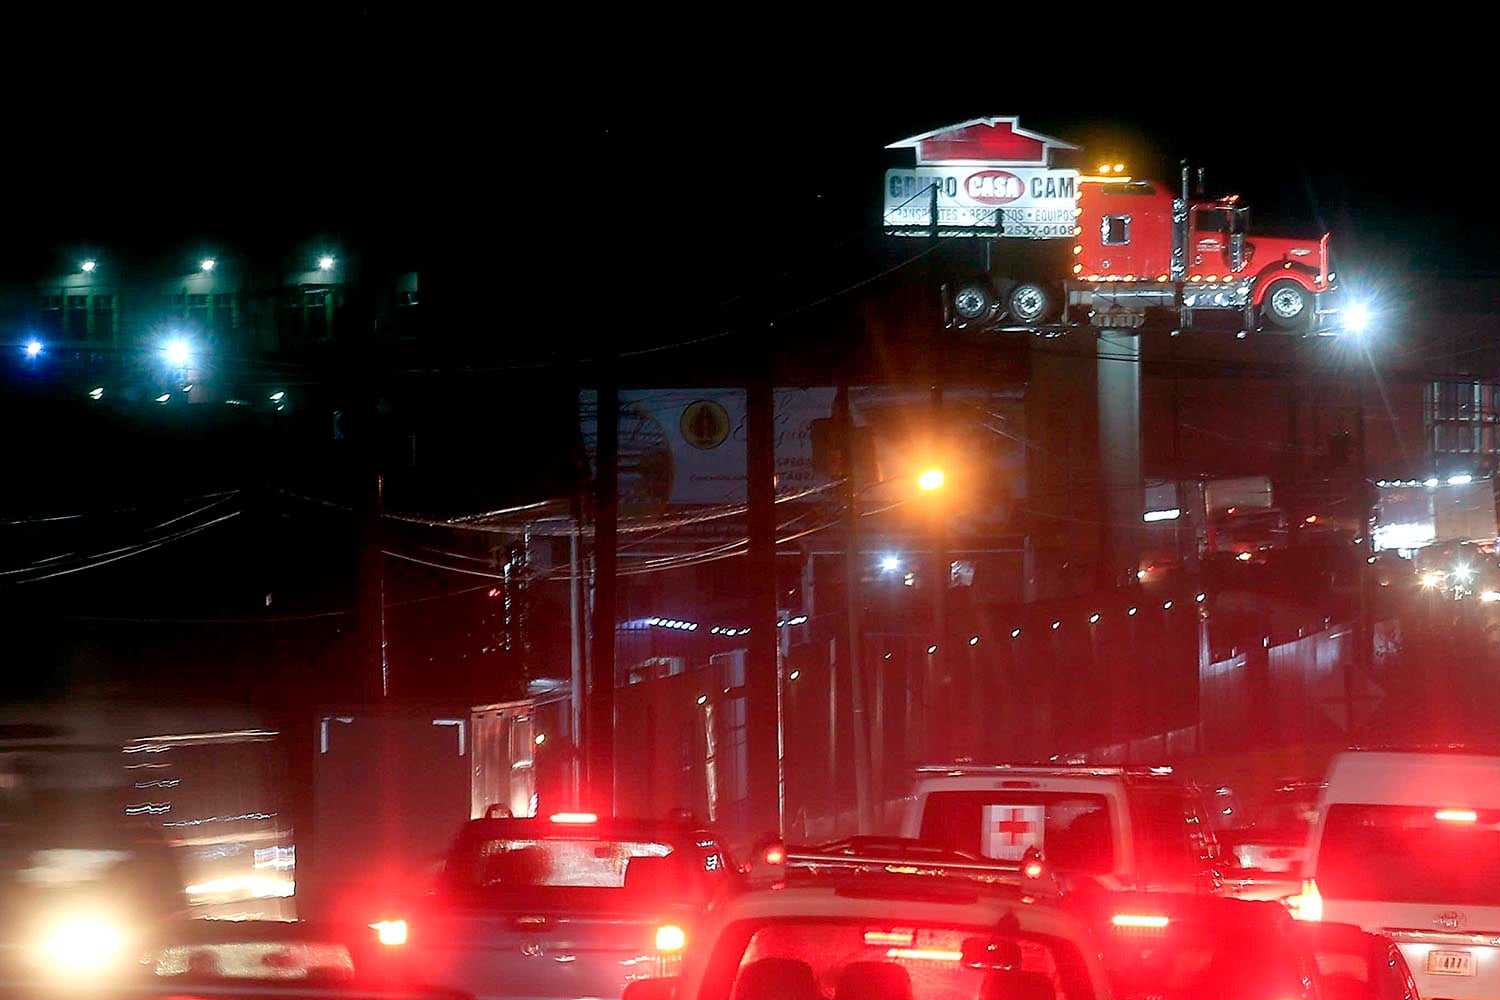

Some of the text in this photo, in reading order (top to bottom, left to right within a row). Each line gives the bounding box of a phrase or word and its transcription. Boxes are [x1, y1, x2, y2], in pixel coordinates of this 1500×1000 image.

[968, 176, 1020, 199] CASA
[1030, 176, 1075, 199] CAM
[889, 207, 959, 222] TRANSPTES
[1035, 209, 1075, 222] EQUIPOS
